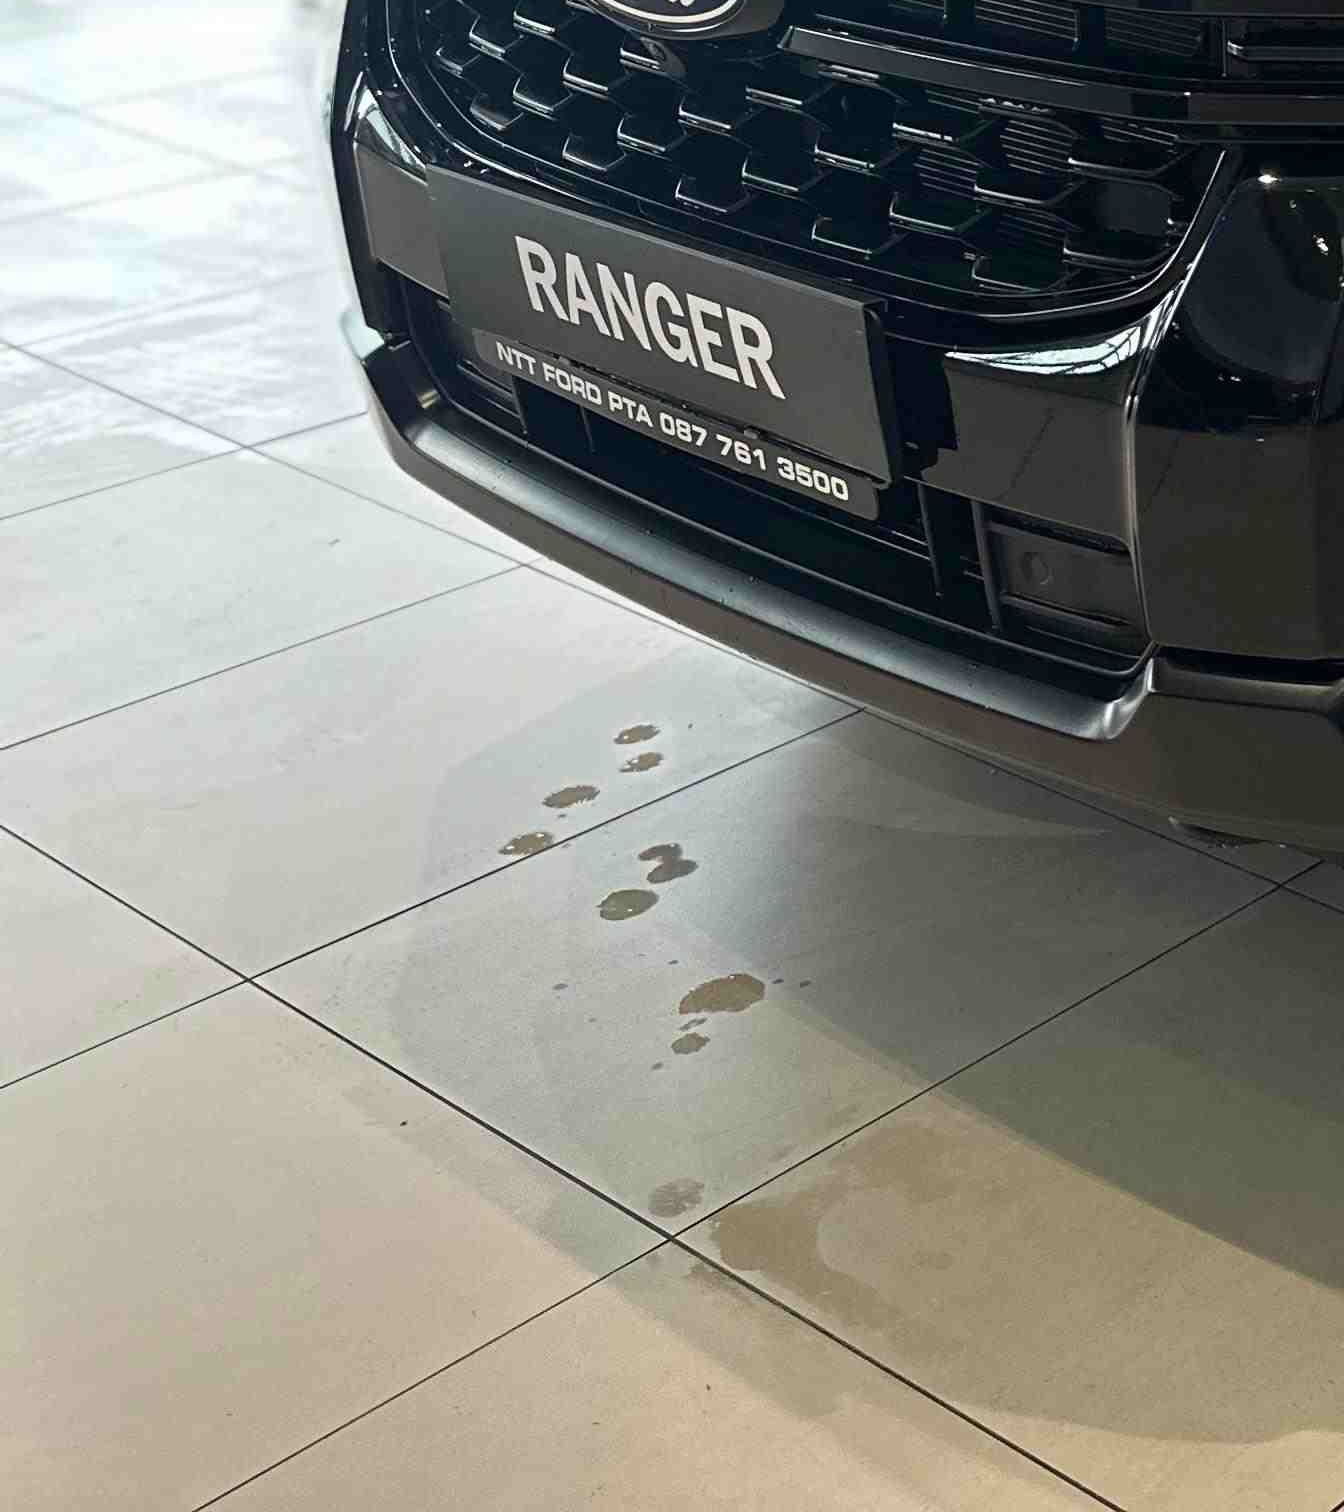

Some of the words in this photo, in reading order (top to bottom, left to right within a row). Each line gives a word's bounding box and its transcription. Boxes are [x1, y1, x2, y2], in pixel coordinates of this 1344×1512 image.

[514, 235, 786, 400] RANGER
[495, 340, 537, 376] NTT
[541, 361, 602, 406] FORD
[607, 389, 654, 428] PTA
[658, 411, 708, 447] 087
[715, 433, 767, 472] 761
[776, 455, 850, 502] 3500
